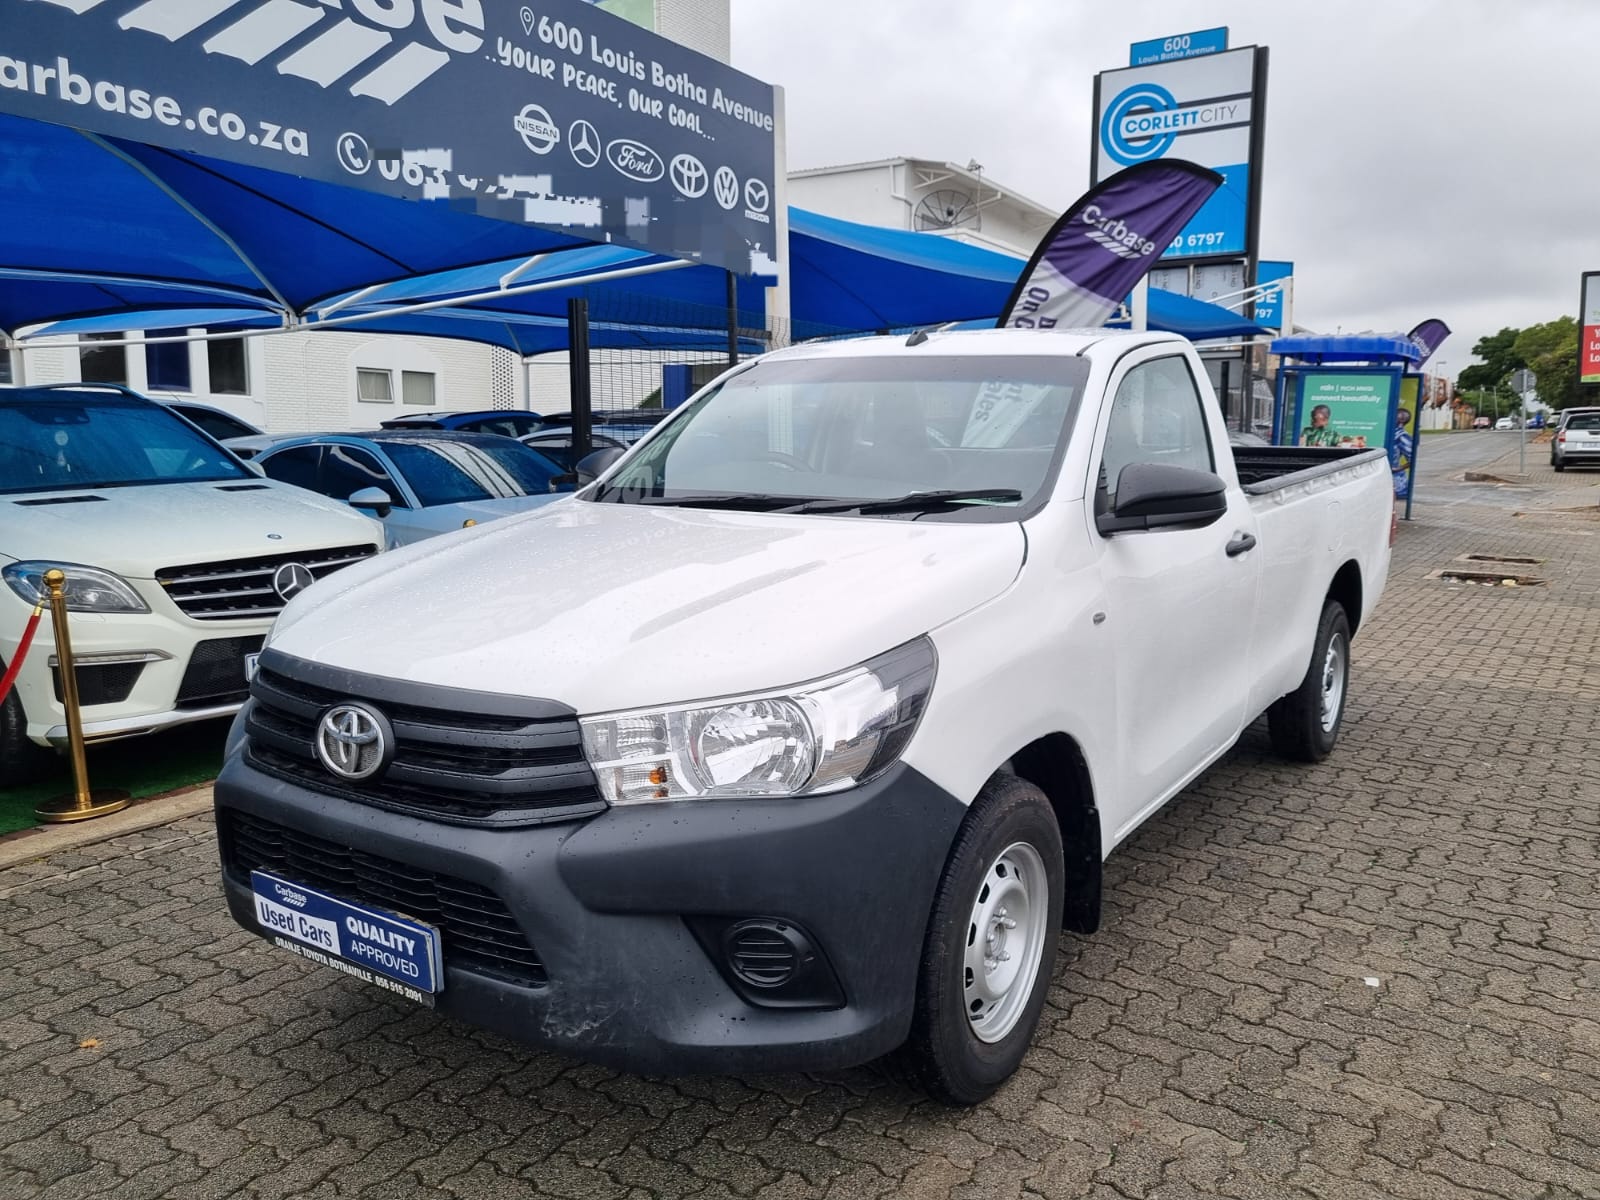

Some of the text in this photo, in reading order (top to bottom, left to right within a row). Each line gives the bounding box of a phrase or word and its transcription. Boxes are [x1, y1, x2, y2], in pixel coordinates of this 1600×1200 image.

[1138, 45, 1216, 65] Louis Botha Avenue
[1163, 35, 1191, 52] 600
[538, 16, 774, 132] 600 Louis Botha Avenue
[562, 62, 623, 109] PEACE,
[628, 88, 664, 119] OUR
[517, 119, 558, 139] NISSAN
[618, 145, 655, 175] Ford
[1082, 205, 1155, 255] Carbase
[1187, 232, 1225, 247] 6797
[275, 883, 307, 903] Carbase
[260, 902, 333, 947] Used Cars
[346, 916, 416, 956] QUALITY
[301, 946, 329, 966] TOYOTA
[328, 956, 373, 983] BOTHAVILLE
[389, 981, 404, 995] 515
[404, 987, 423, 1003] 2091
[351, 940, 419, 978] APPROVED
